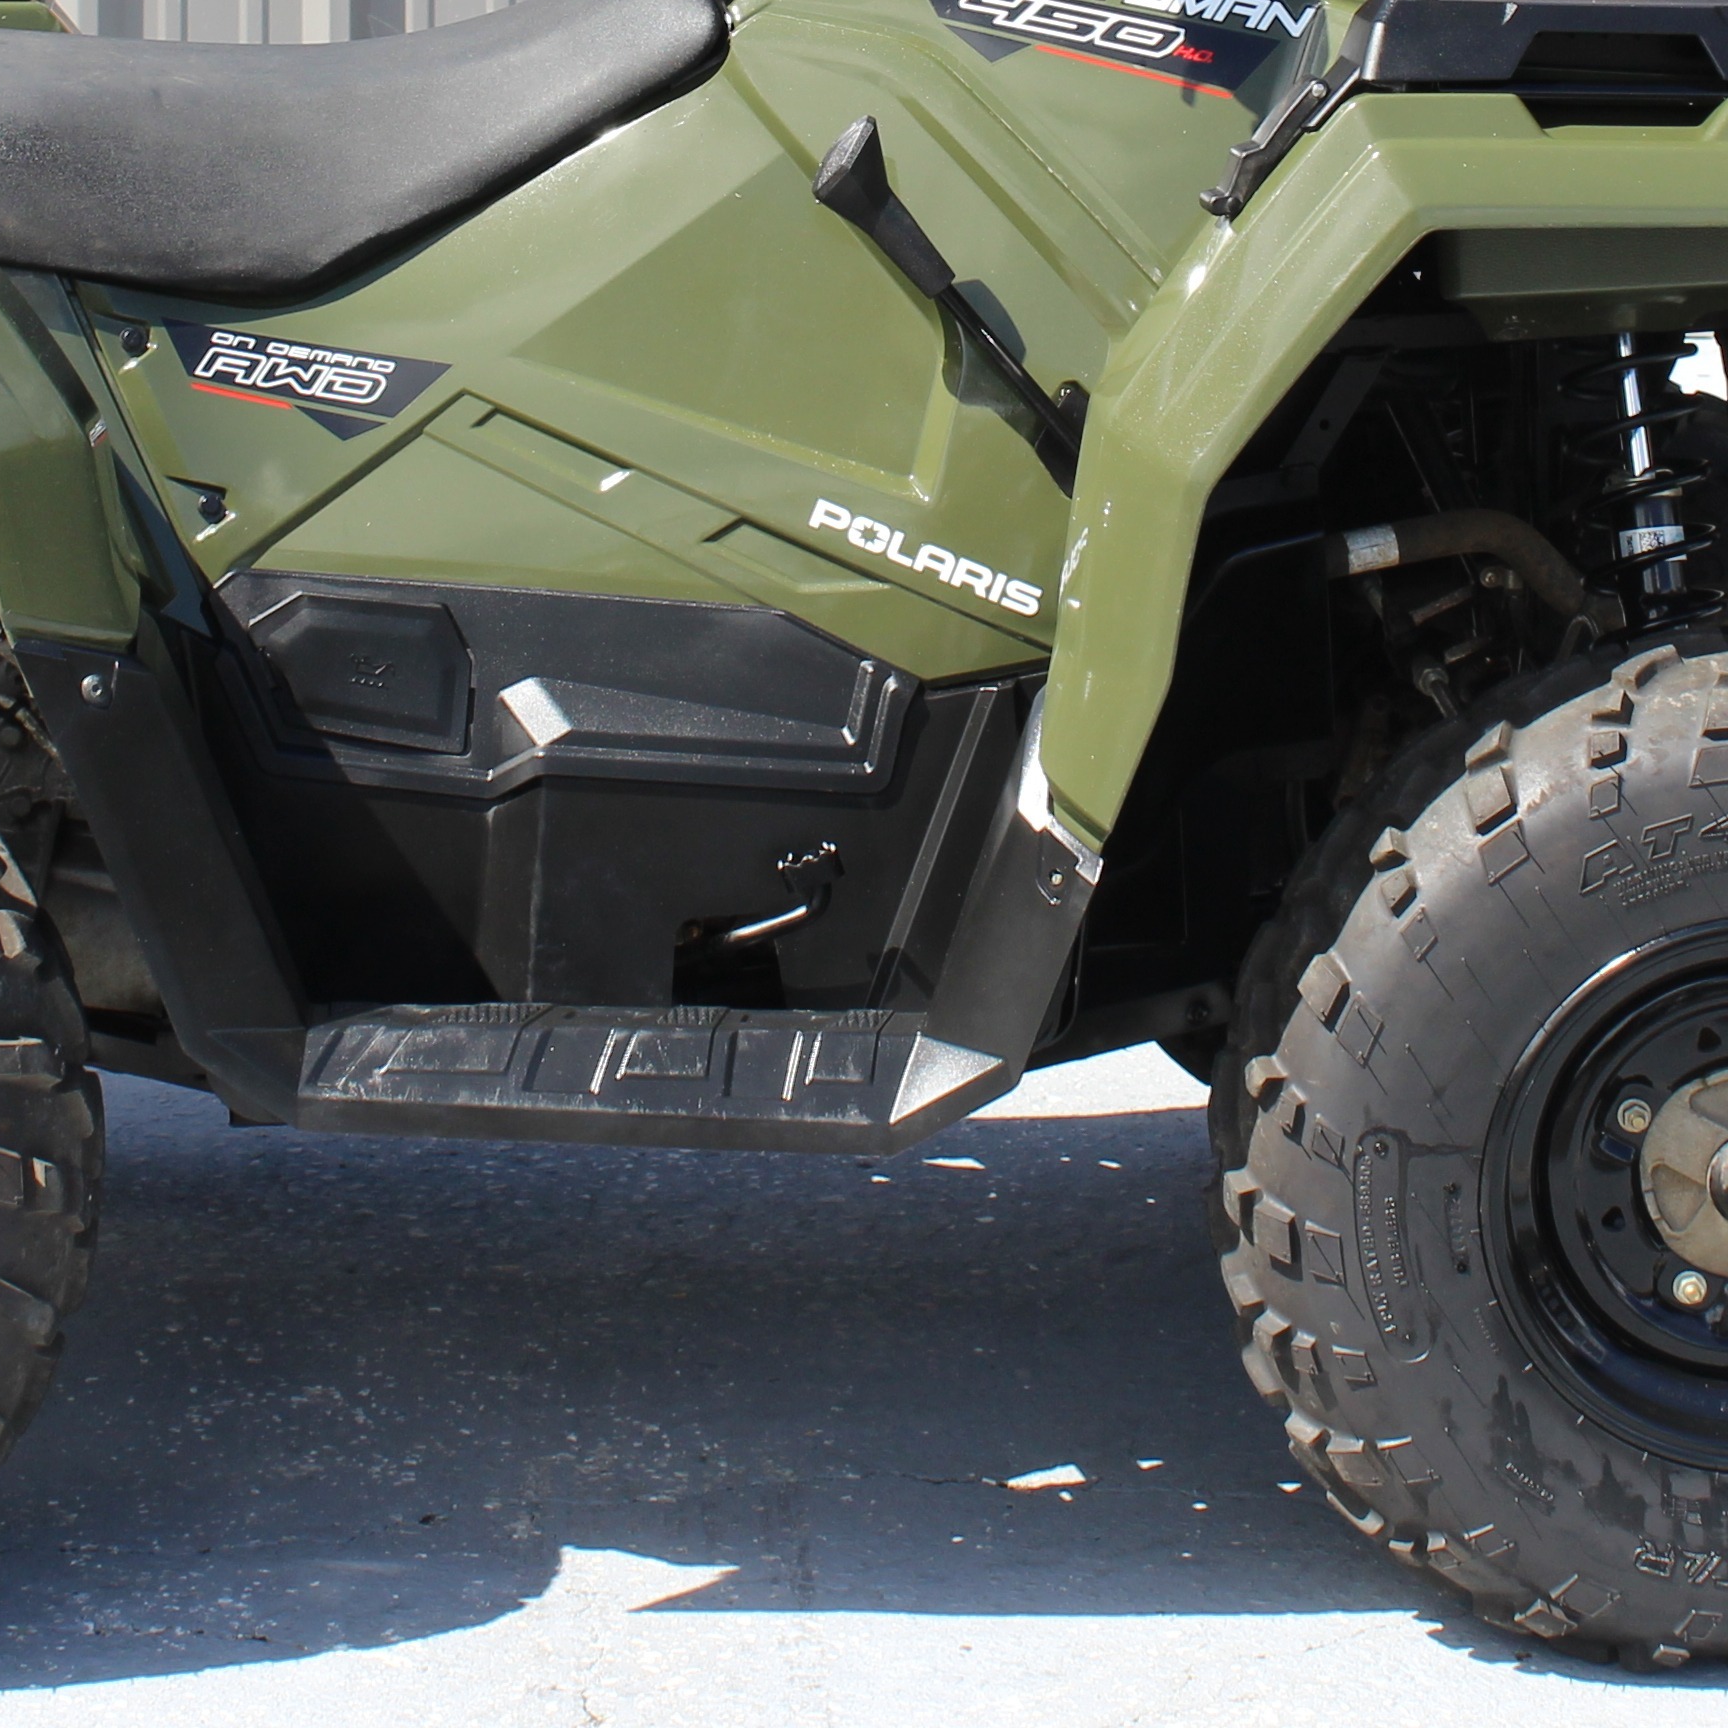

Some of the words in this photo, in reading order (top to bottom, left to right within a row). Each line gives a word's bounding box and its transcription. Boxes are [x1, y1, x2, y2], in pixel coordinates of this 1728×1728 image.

[193, 346, 387, 405] AWD
[210, 330, 256, 349] ON
[267, 341, 396, 374] DEMAND
[808, 497, 1044, 617] POLARIS
